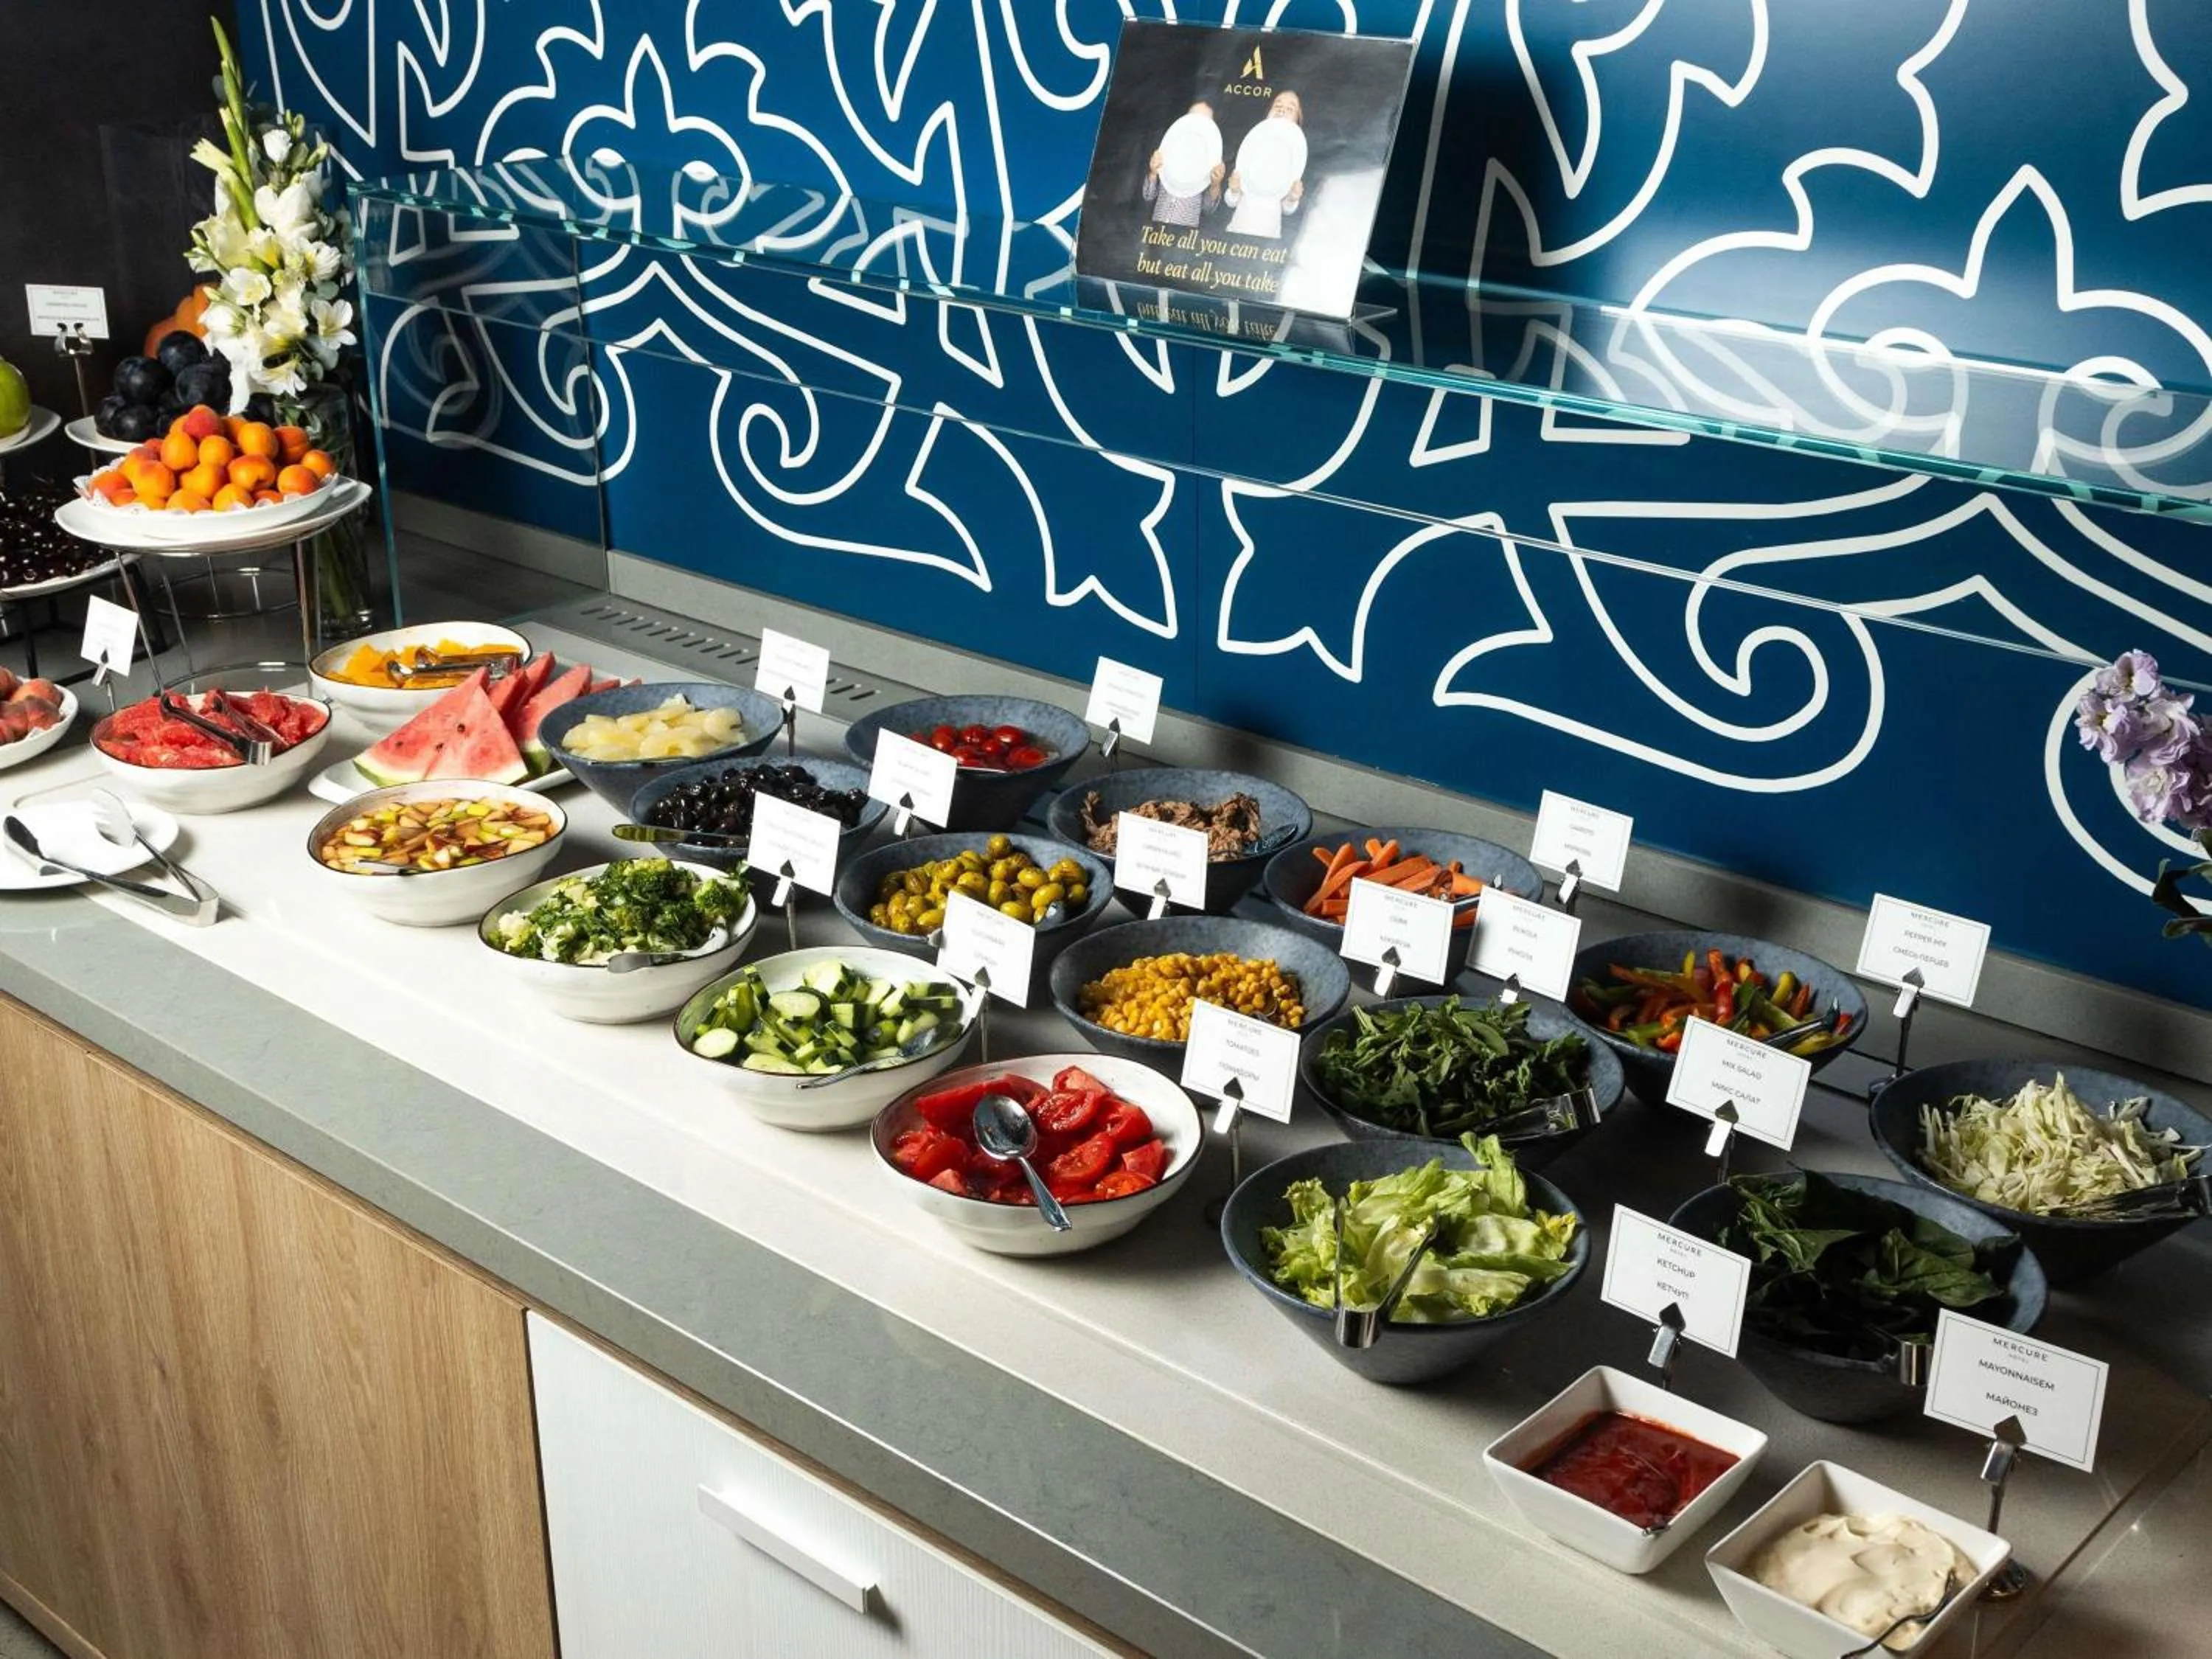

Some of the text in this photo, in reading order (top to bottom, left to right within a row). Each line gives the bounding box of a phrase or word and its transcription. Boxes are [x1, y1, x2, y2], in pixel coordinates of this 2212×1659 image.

[1224, 83, 1273, 98] ACCOR
[1140, 225, 1288, 263] Take all you can eat
[1136, 253, 1279, 293] but eat all you take
[1910, 911, 1950, 928] MERCURE
[1726, 1038, 1768, 1060] MERCURE
[1722, 1059, 1762, 1081] MIX SALAD
[1658, 1232, 1703, 1257] MERCURE
[1657, 1257, 1697, 1279] KETCHUP
[1993, 1337, 2050, 1363] MERCURE
[1978, 1358, 2056, 1391] MAYONNAISEM
[1986, 1391, 2039, 1416] МАЙОНЕЗ
